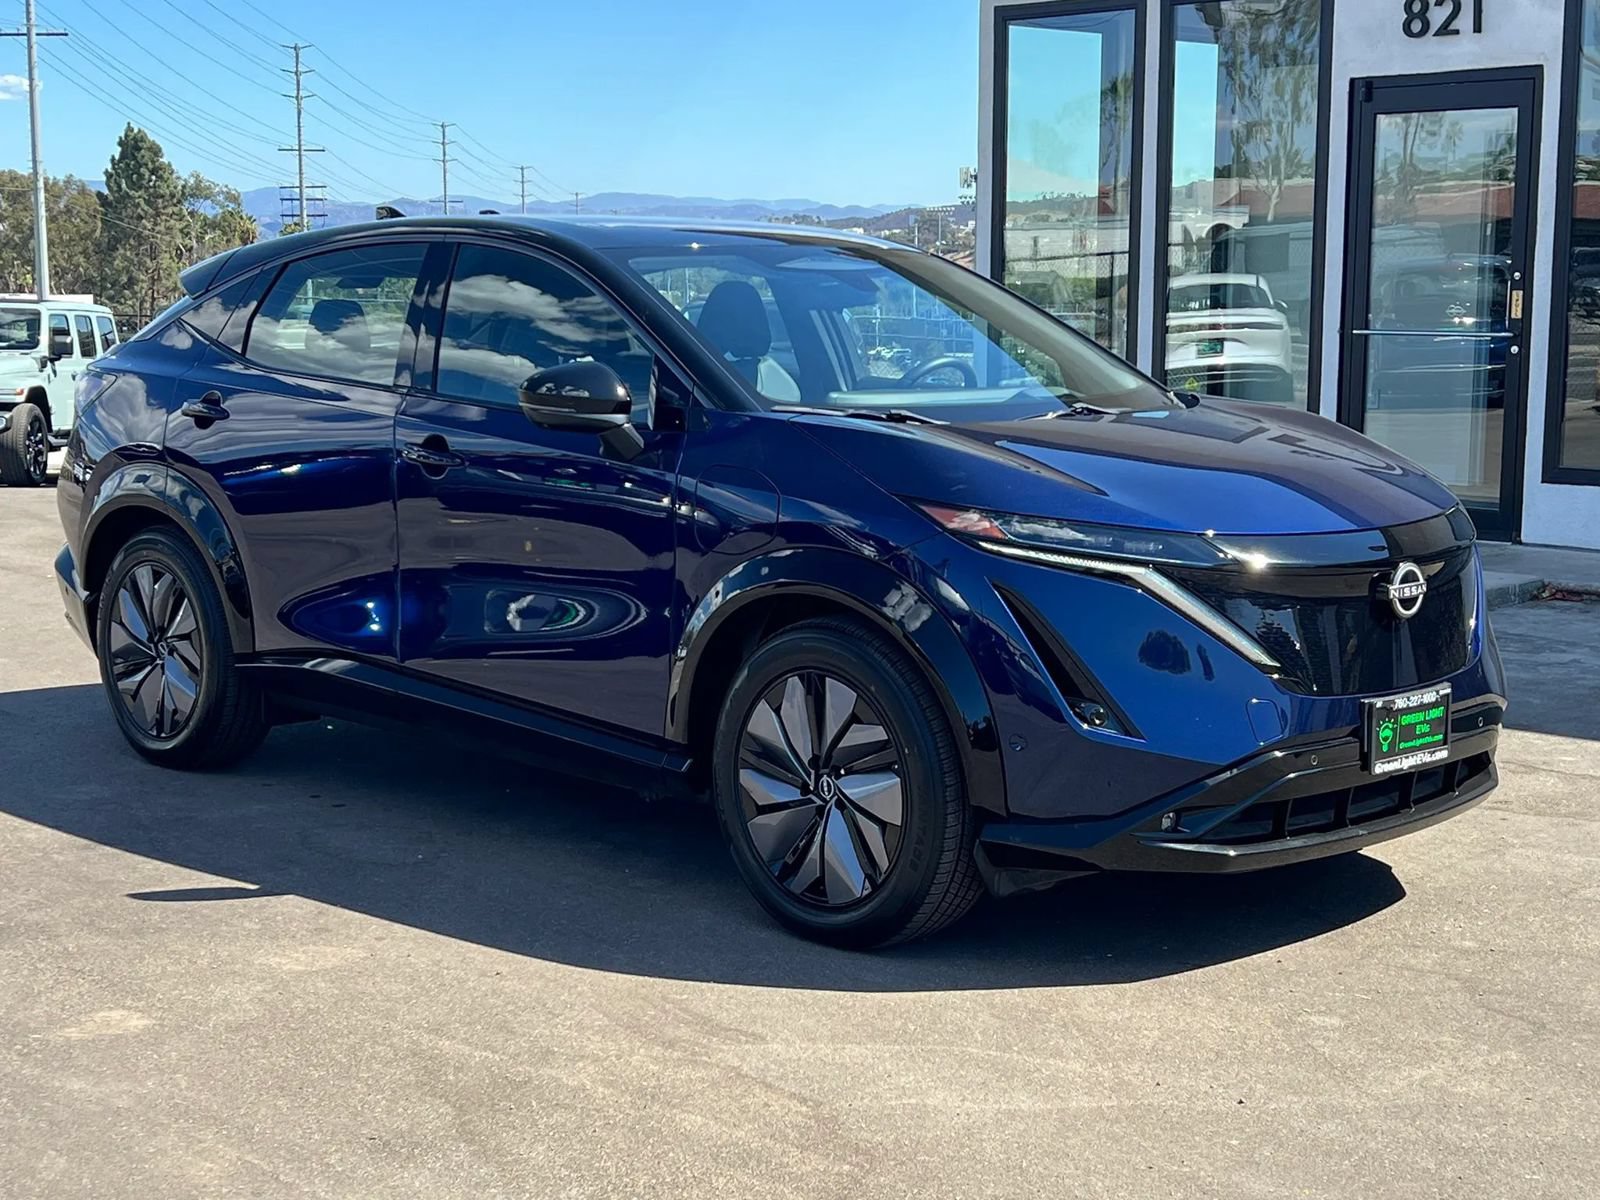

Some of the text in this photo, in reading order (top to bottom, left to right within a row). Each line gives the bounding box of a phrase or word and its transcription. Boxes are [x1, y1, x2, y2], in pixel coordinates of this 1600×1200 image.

[1402, 0, 1482, 38] 821
[1389, 583, 1427, 599] NISSAN
[1401, 706, 1445, 725] GREEN LIGHT
[1374, 750, 1449, 775] GreenLightEVs.com
